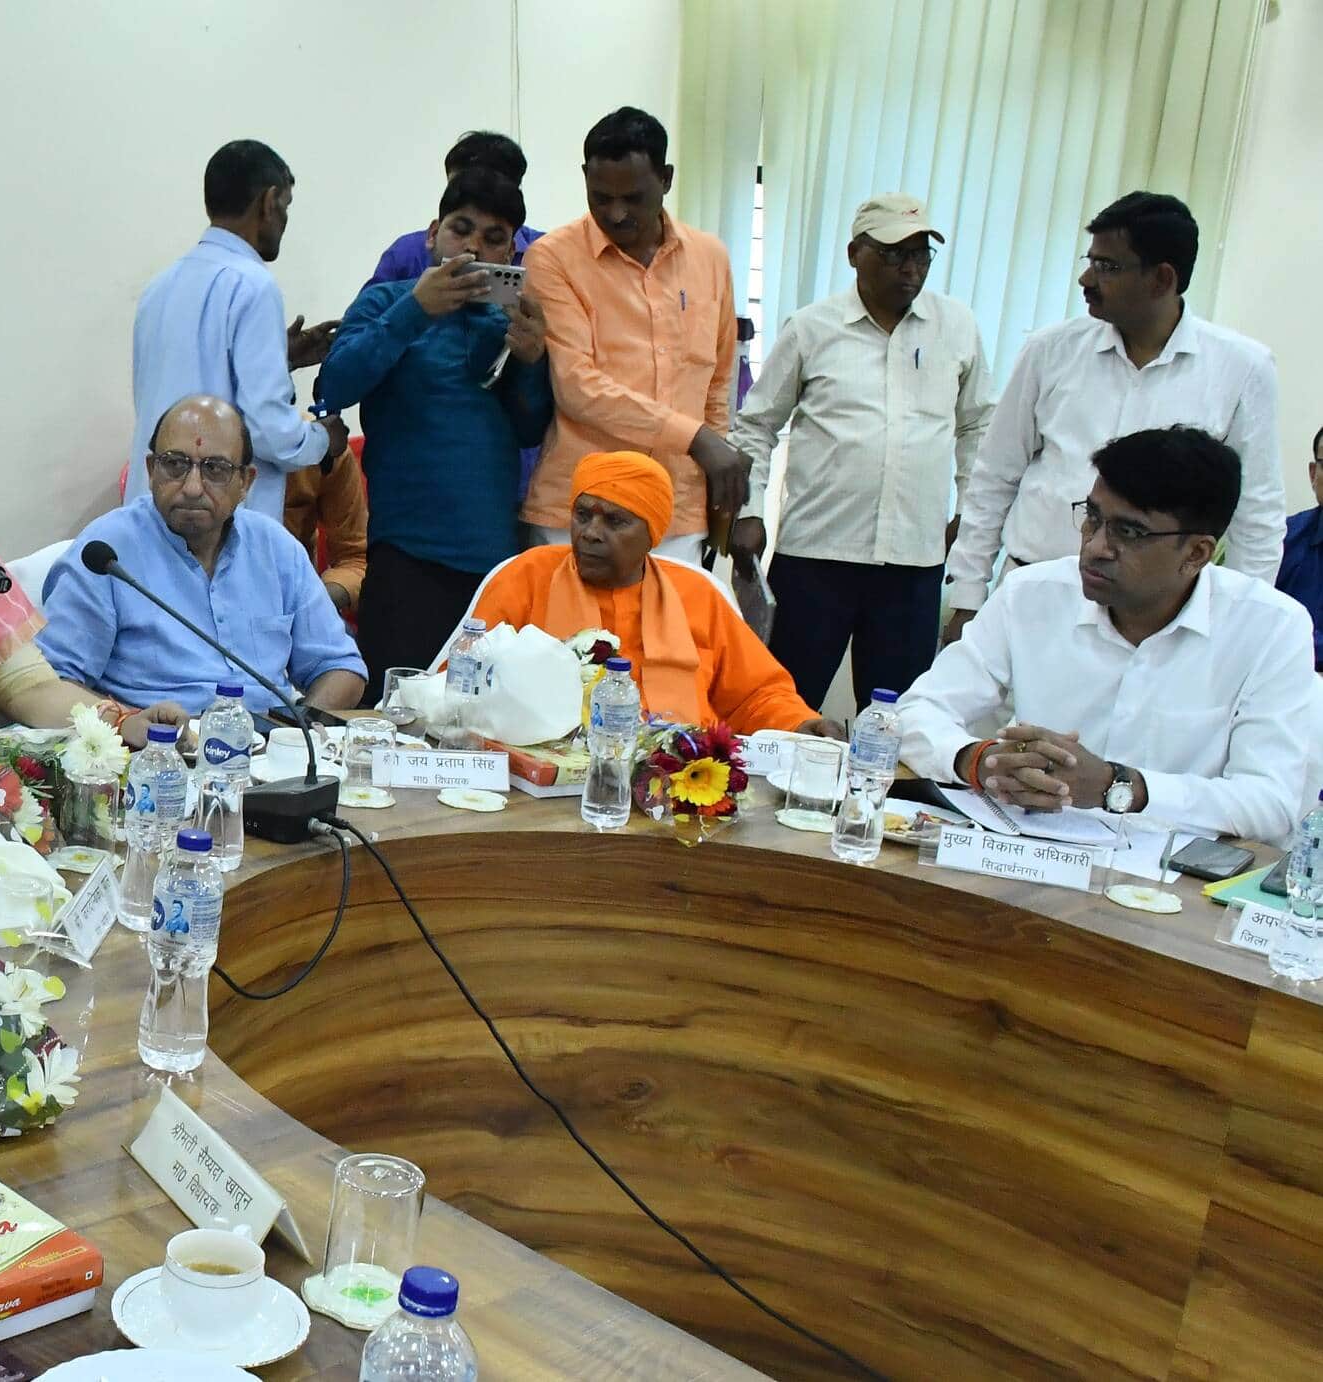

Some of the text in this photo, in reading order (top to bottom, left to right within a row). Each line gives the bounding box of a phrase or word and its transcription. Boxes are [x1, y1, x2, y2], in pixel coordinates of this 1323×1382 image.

[406, 756, 428, 767] जय
[436, 757, 465, 770] प्रताप
[473, 756, 495, 771] सिंह
[435, 774, 470, 786] विधायक
[943, 831, 1091, 868] मुख्य विकास अधिकारी
[1239, 929, 1270, 947] जिला
[171, 1121, 198, 1154] श्रीमती
[225, 1175, 253, 1211] खातून
[186, 1173, 221, 1215] विधायक
